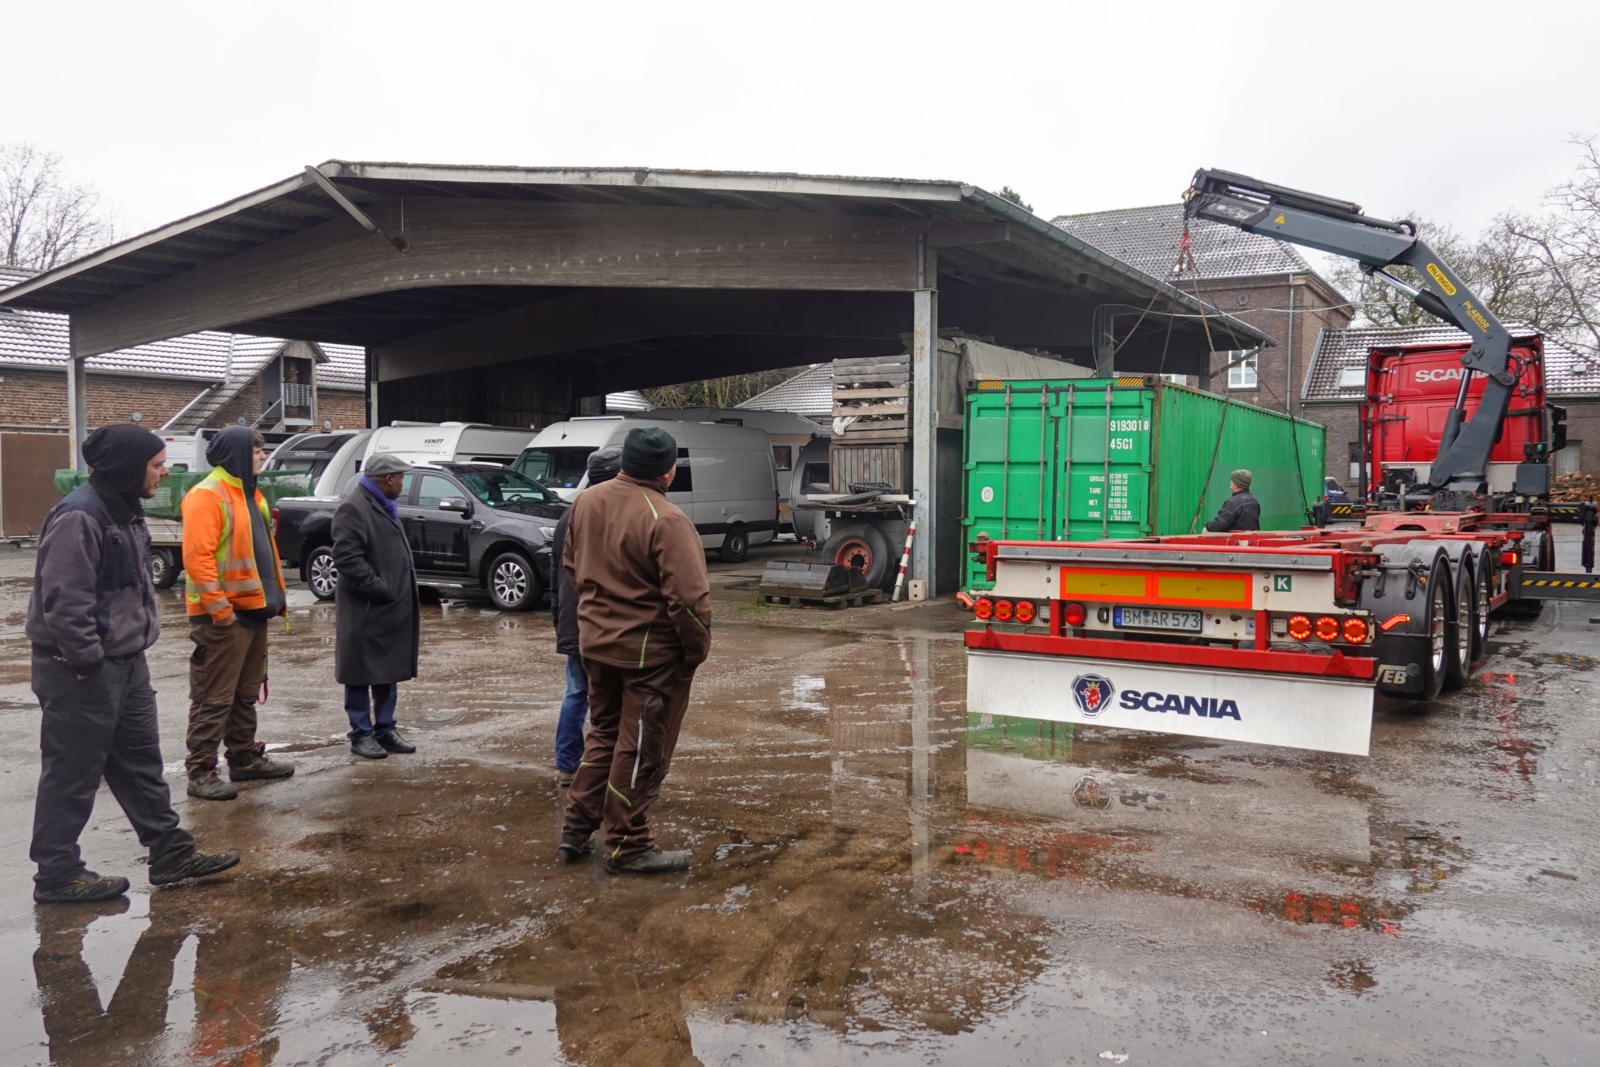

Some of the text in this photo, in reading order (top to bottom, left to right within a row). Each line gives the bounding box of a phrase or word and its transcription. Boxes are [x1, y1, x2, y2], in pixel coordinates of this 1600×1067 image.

[1428, 265, 1455, 294] PALFINGER
[1462, 300, 1473, 310] PK
[1110, 420, 1142, 432] 919301
[1110, 438, 1133, 450] 45G1
[1277, 577, 1288, 590] K
[1123, 609, 1141, 625] BM
[1151, 612, 1169, 627] AR
[1172, 613, 1200, 628] 573
[1119, 689, 1242, 721] SCANIA
